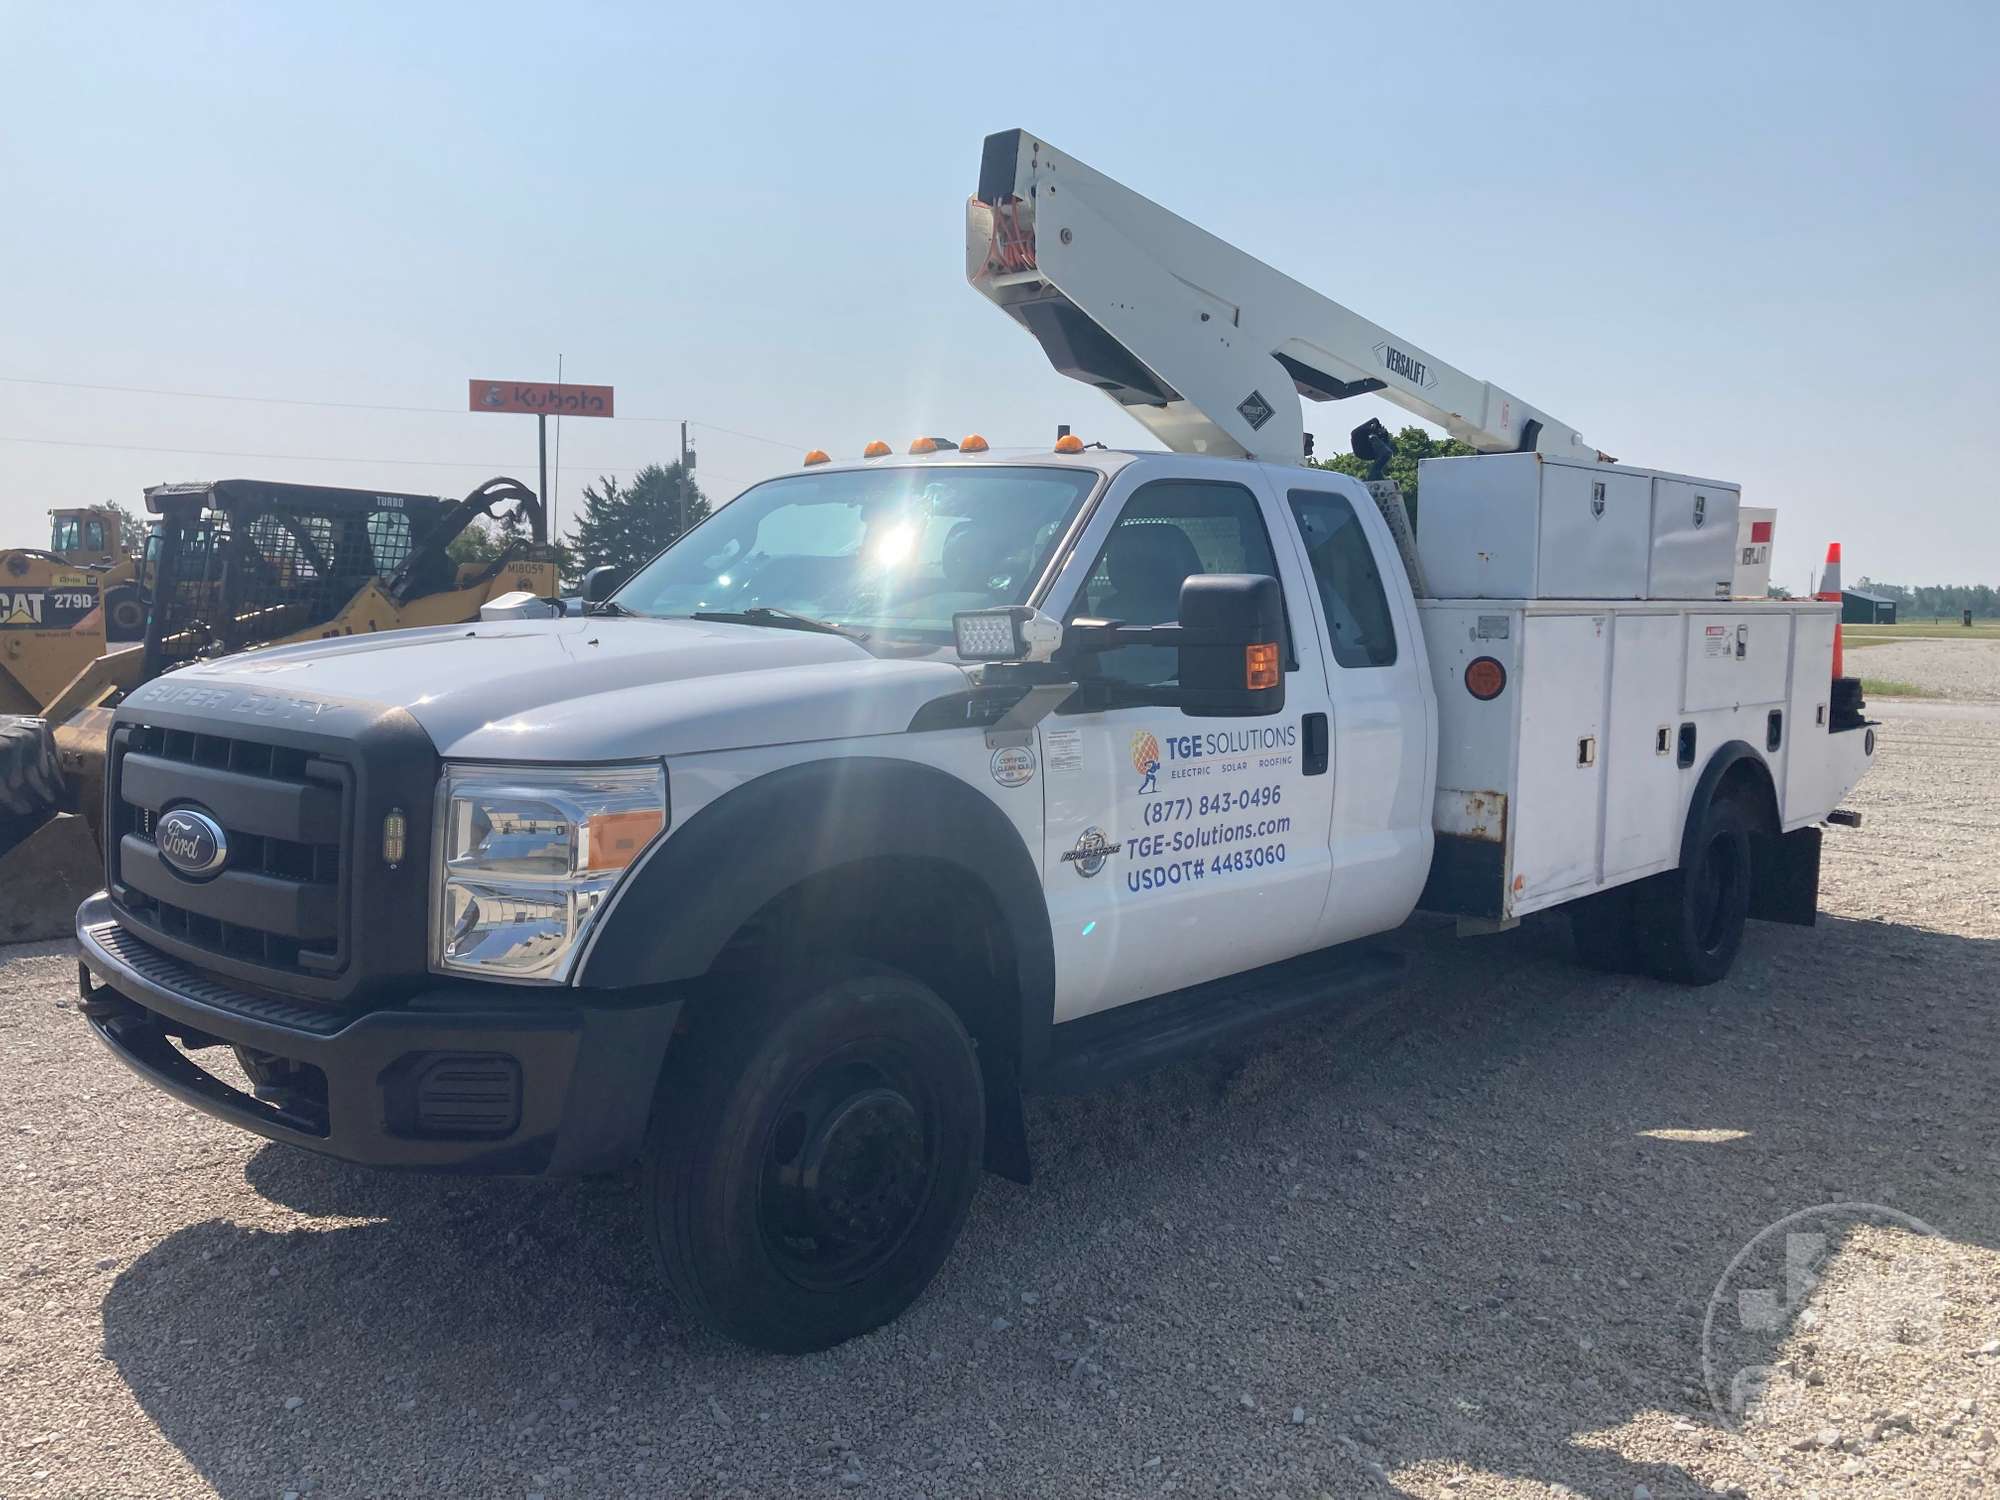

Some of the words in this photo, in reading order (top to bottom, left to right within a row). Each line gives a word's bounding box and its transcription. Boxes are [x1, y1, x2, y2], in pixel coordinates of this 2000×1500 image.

[1386, 345, 1427, 387] VERSALIFT
[513, 386, 605, 411] Kubota
[376, 496, 404, 508] TURBO
[0, 593, 45, 624] CAT
[144, 684, 232, 710] SUPER
[1166, 735, 1202, 760] TGE
[1206, 726, 1297, 755] SOLUTIONS
[1171, 766, 1211, 779] ELECTRIC
[1222, 761, 1248, 773] SOLAR
[1259, 756, 1293, 768] ROOFING
[1144, 797, 1193, 826] (877)
[1199, 784, 1281, 816] 843-0496
[163, 818, 201, 860] Ford
[1127, 816, 1290, 860] TGE-Solutions.com
[1128, 858, 1205, 892] USDOT#
[1211, 843, 1286, 875] 4483060
